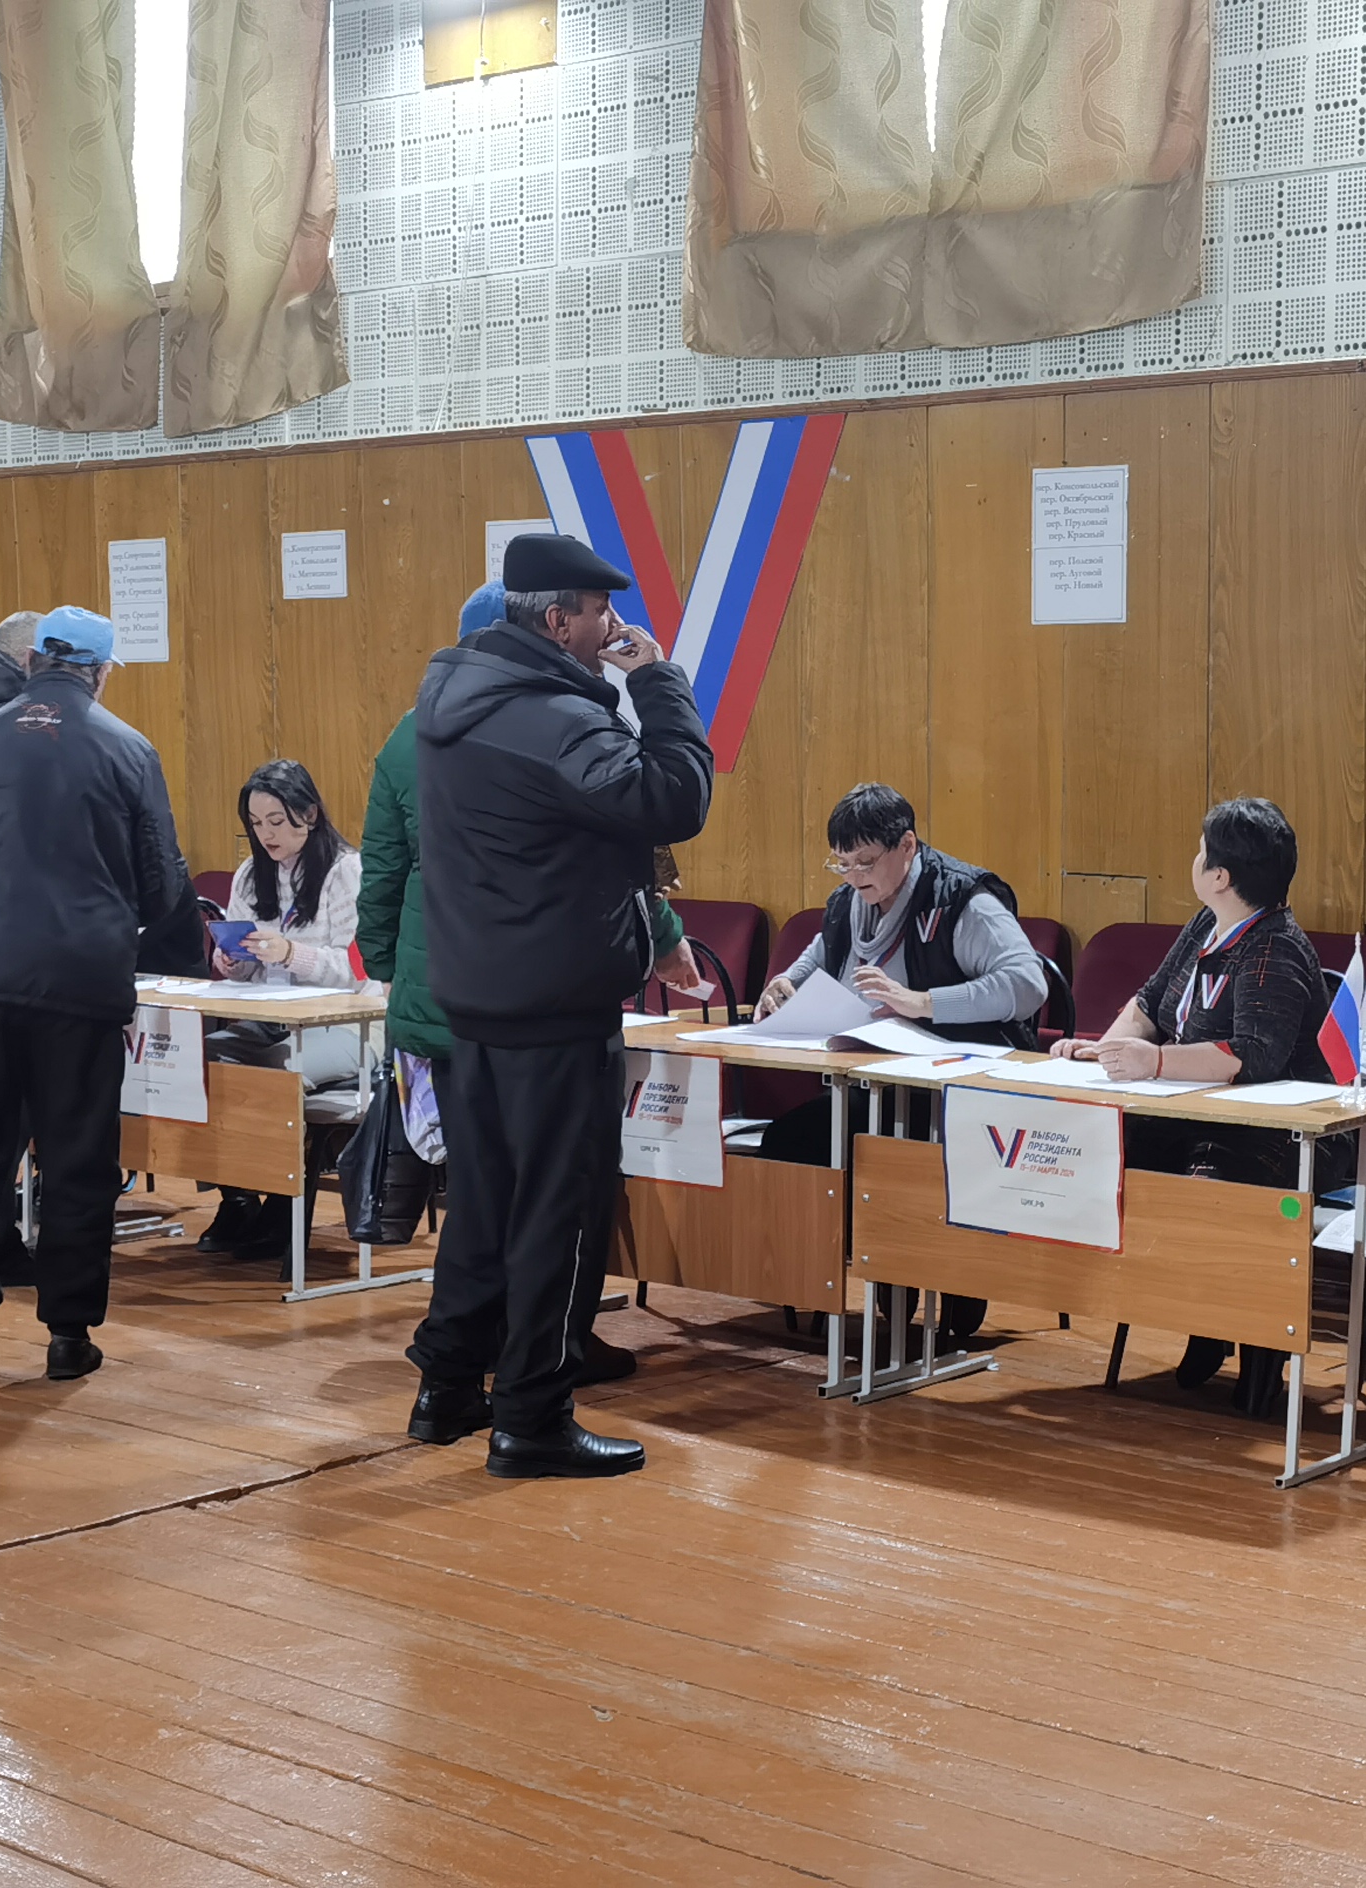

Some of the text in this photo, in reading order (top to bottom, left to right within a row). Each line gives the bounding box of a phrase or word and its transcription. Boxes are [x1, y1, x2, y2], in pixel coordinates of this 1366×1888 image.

[1074, 581, 1103, 589] Новый
[647, 1082, 680, 1093] ВЫБОРЫ
[643, 1093, 689, 1105] ПРЕЗИДЕНТА
[639, 1103, 670, 1113] РОССИИ
[1031, 1130, 1070, 1143] ВЫБОРЫ
[1027, 1141, 1082, 1157] ПРЕЗИДЕНТА
[1023, 1153, 1058, 1166] РОССИИ
[1036, 1165, 1059, 1176] МАРТА
